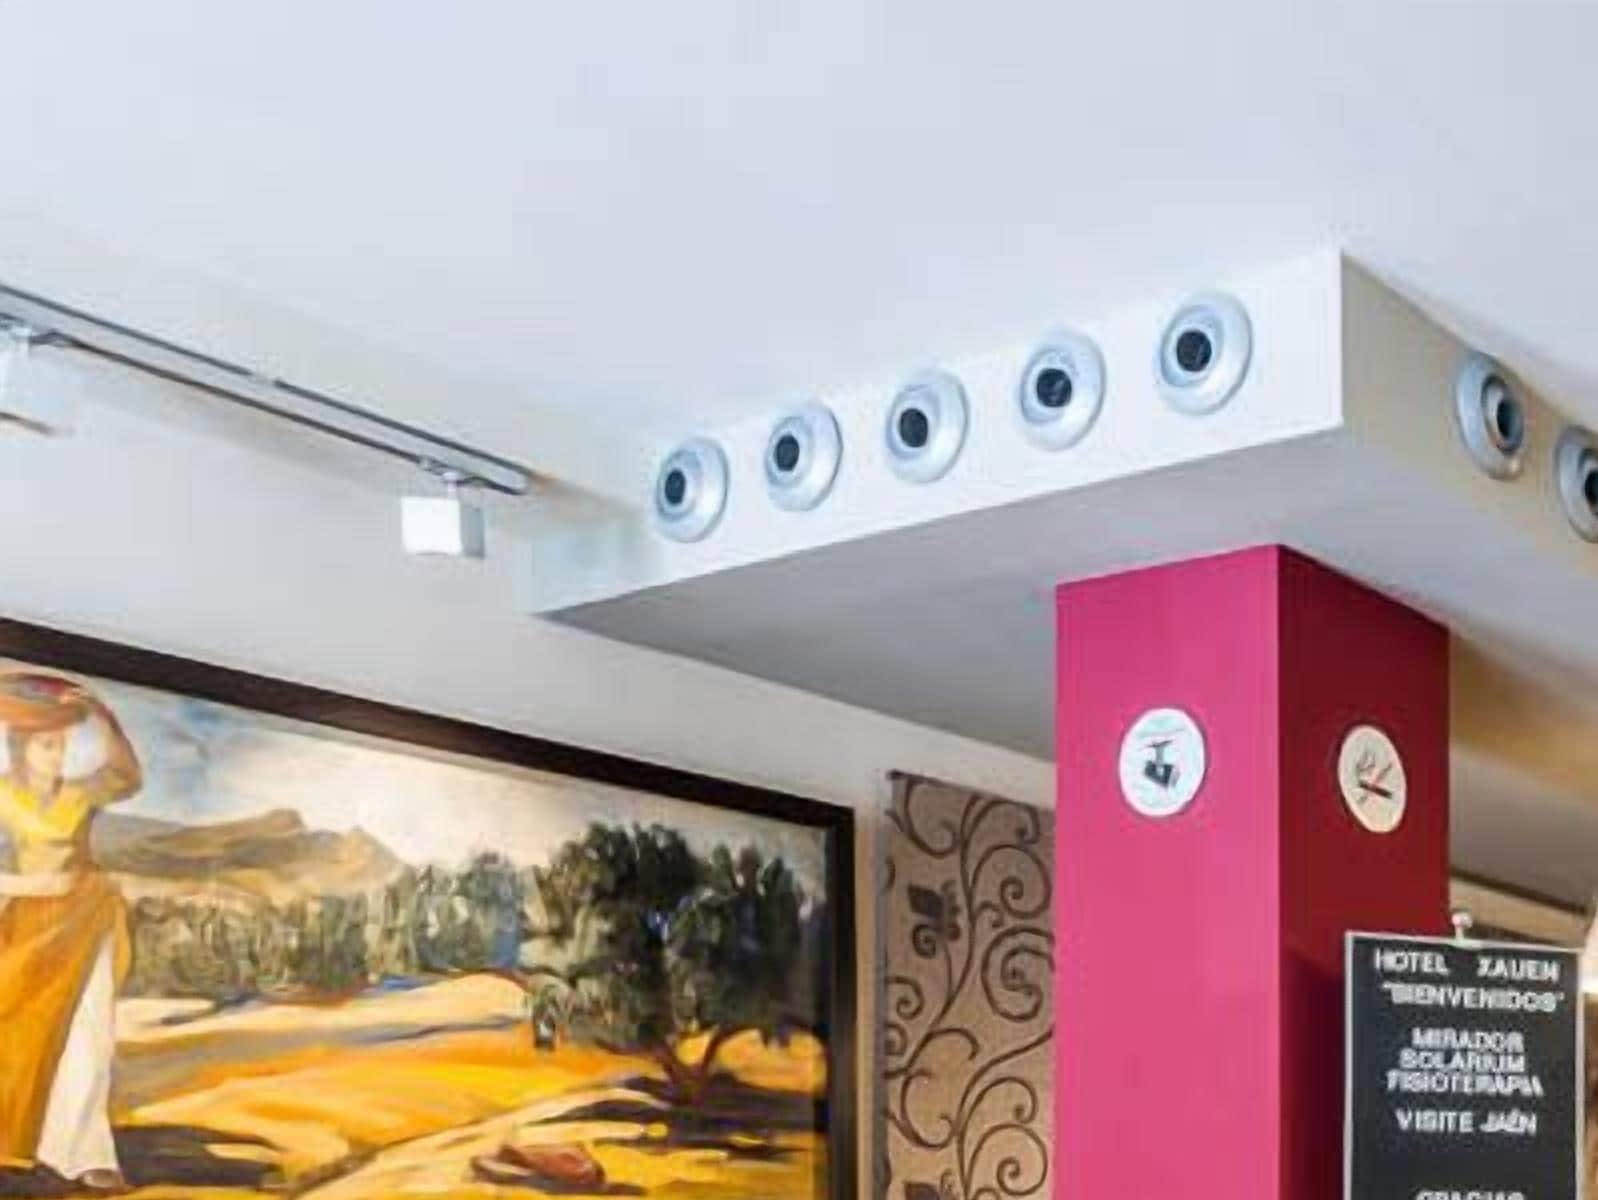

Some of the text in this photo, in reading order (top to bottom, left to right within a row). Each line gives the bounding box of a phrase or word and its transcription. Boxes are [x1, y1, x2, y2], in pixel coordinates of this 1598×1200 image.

[1375, 948, 1449, 975] HOTEL
[1412, 1027, 1524, 1052] MIRADOR
[1400, 1048, 1525, 1073] SOLARIUM
[1395, 1108, 1474, 1133] VISITE
